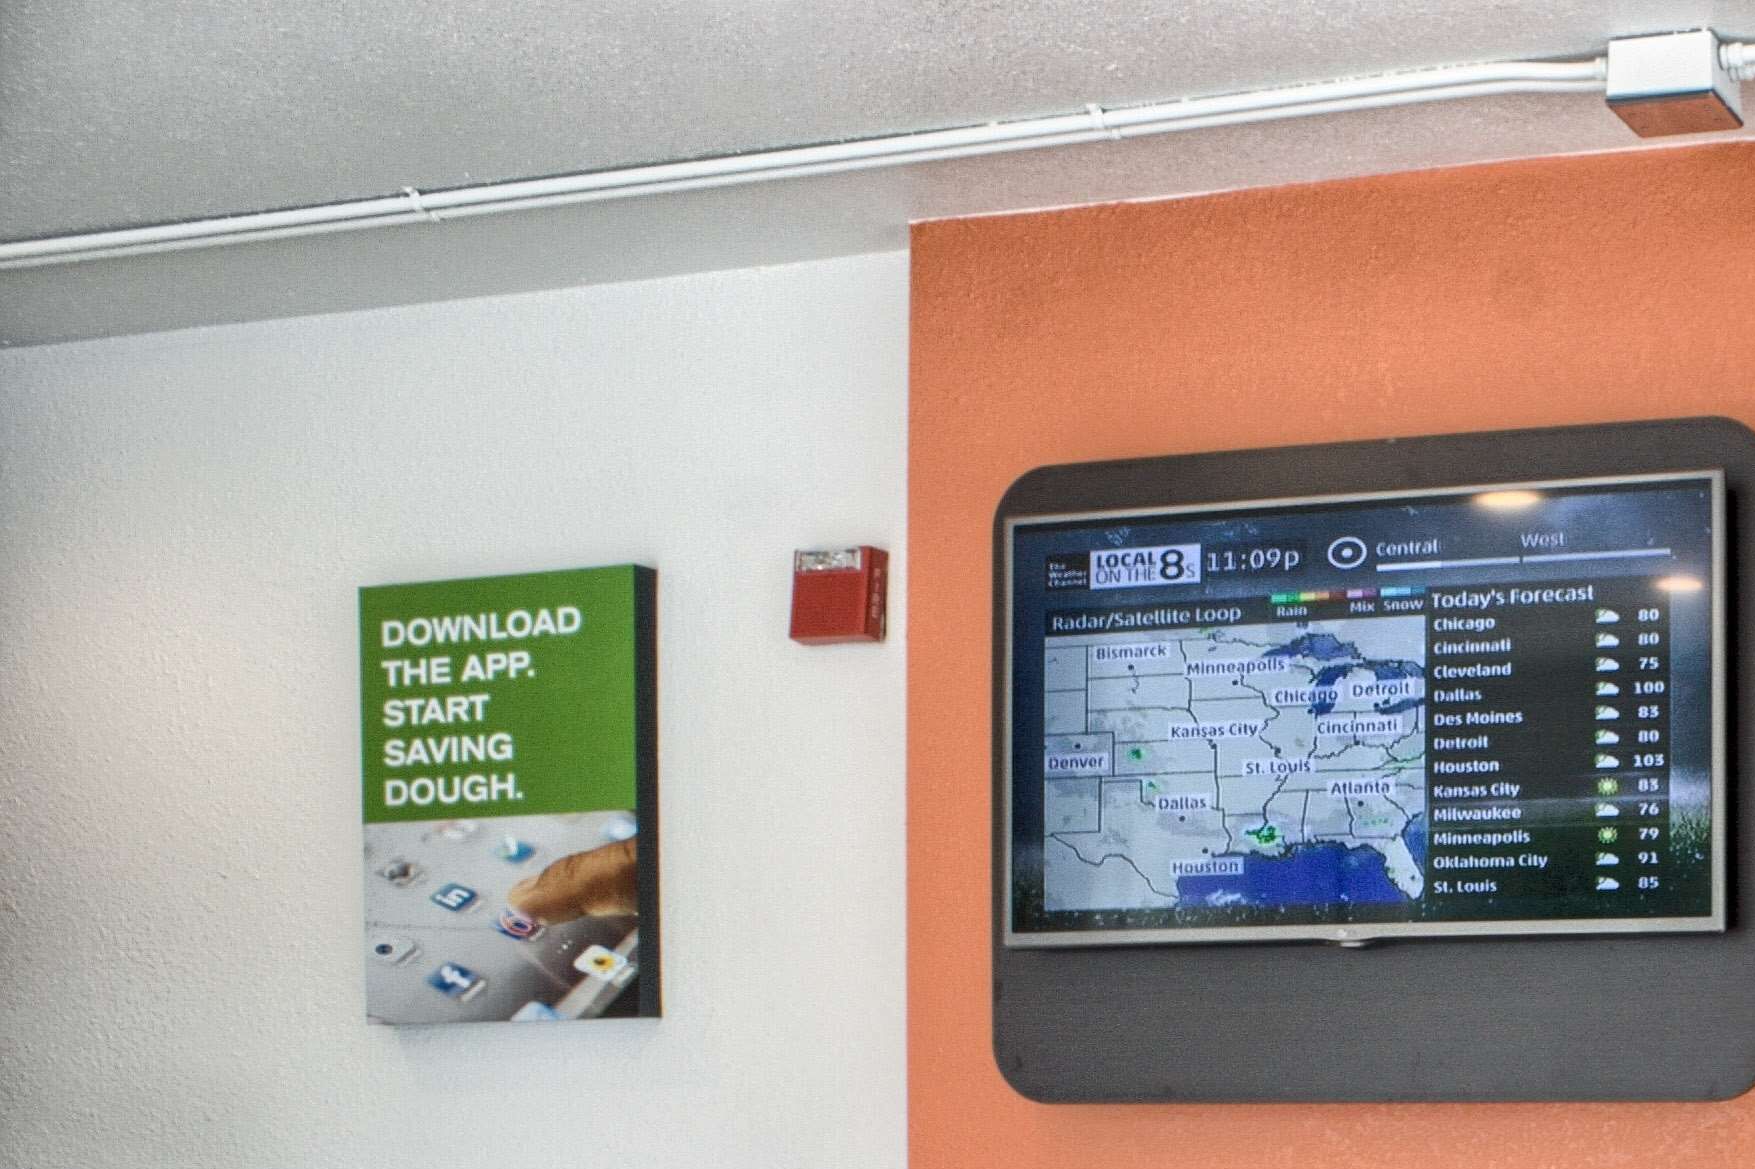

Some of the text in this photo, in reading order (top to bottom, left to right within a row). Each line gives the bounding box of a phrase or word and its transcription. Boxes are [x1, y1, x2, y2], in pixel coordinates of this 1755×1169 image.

[1375, 538, 1439, 557] Central
[1520, 532, 1566, 548] West
[1096, 550, 1157, 569] LOCAL
[1207, 547, 1300, 571] 11:09p
[1095, 565, 1157, 584] ON THE
[1383, 598, 1424, 612] Snow
[1431, 585, 1594, 609] Today's Forecast
[1276, 605, 1308, 617] Rain
[1350, 600, 1376, 613] Mix
[381, 605, 582, 648] DOWNLOAD
[1052, 606, 1243, 631] Radar/Satellite Loop
[1433, 608, 1660, 632] Chicago 80
[1096, 644, 1167, 661] Bismarck
[1433, 632, 1660, 655] Cincinnati 80
[382, 650, 536, 688] THE APP.
[1186, 658, 1286, 675] Minneapolis
[1433, 656, 1660, 679] Cleveland 75
[1274, 687, 1339, 705] Chicago
[1352, 681, 1411, 698] Detroit
[1433, 680, 1665, 702] Dallas 100
[383, 693, 490, 728] START
[1433, 712, 1463, 726] Des
[1466, 710, 1524, 725] Moines
[1171, 721, 1260, 739] Kansas City
[1317, 719, 1398, 735] Cincinnati
[1433, 729, 1660, 750] Detroit 80
[383, 733, 514, 768] SAVING
[1047, 755, 1105, 771] Denver
[1245, 758, 1312, 775] St. Louis
[1433, 759, 1500, 774] Houston
[384, 771, 524, 807] DOUGH.
[1330, 780, 1391, 796] Atlanta
[1433, 783, 1488, 799] Kansas
[1490, 781, 1521, 798] City
[1158, 794, 1207, 811] Dallas
[1433, 802, 1660, 822] Milwaukee 76
[1433, 826, 1660, 846] Minneapolis 79
[1171, 860, 1240, 875] Houston
[1433, 851, 1659, 869] Oklahoma City 91
[1433, 876, 1660, 894] St. Louis 85
